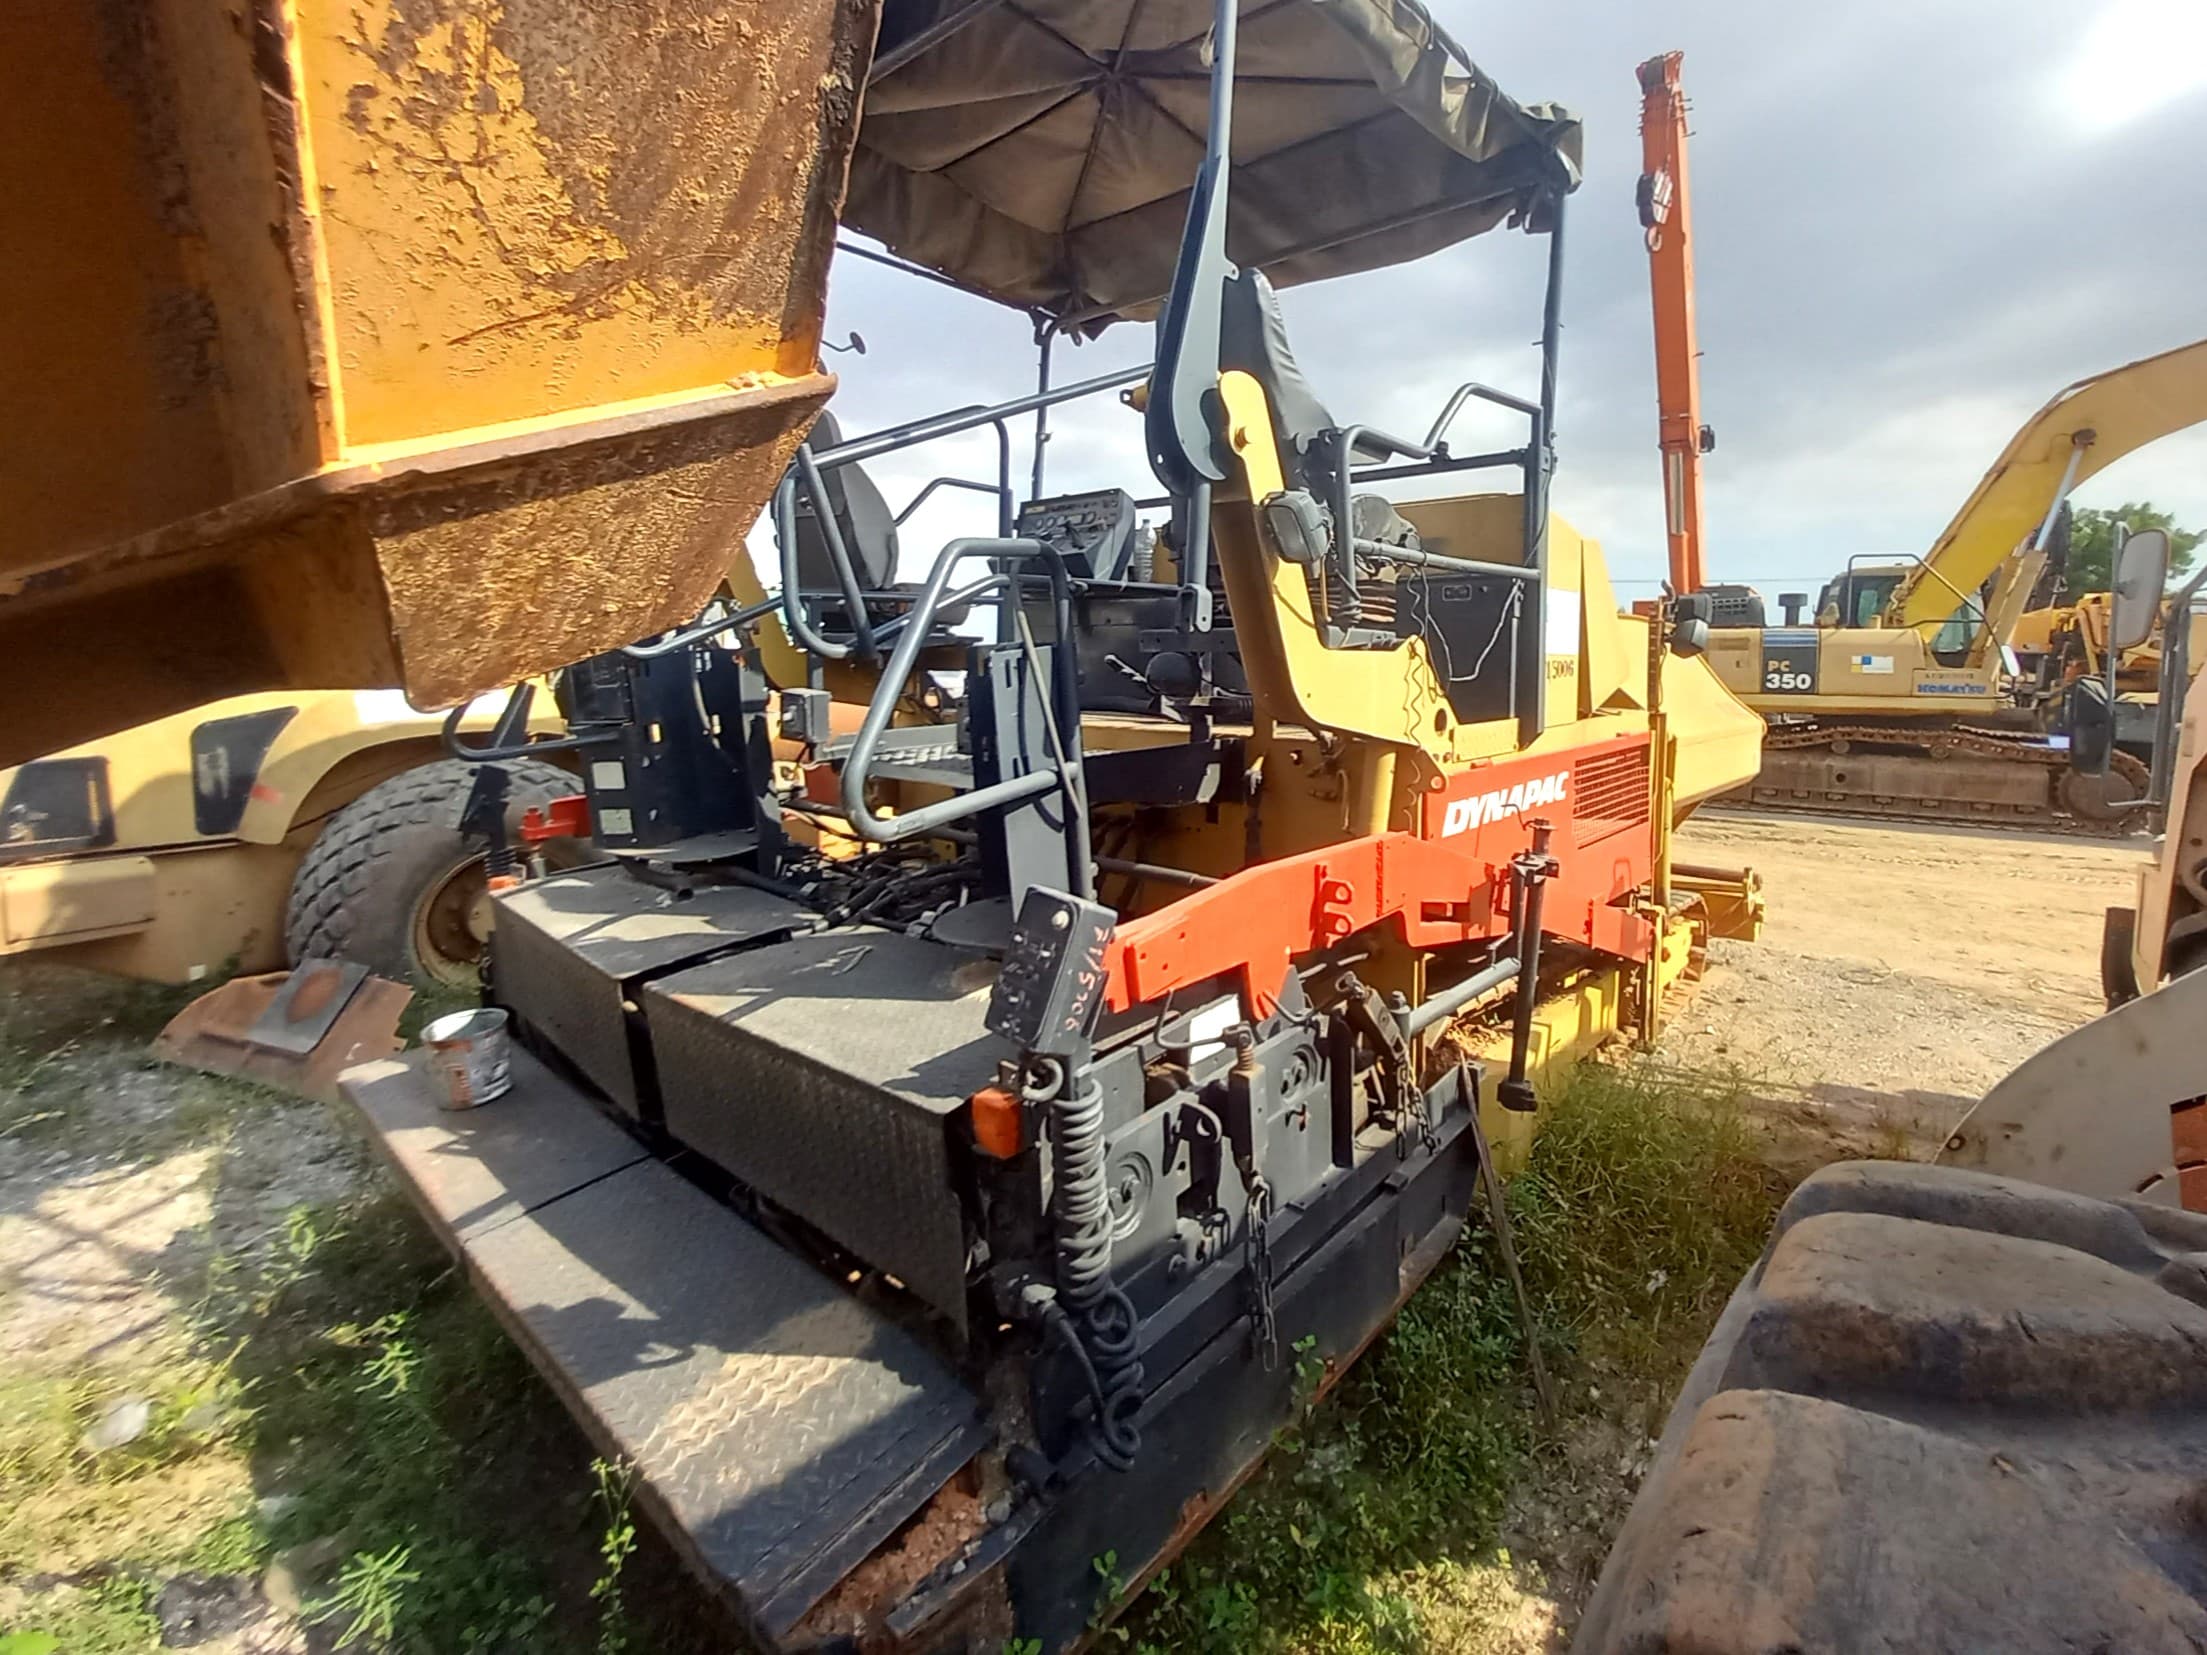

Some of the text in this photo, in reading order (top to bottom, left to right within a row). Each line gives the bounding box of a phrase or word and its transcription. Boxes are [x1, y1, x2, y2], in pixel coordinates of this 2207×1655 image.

[1767, 660, 1790, 672] PC
[1765, 673, 1812, 690] 350
[1917, 683, 1986, 694] KOMATSU
[1441, 771, 1569, 838] DYNAPAC
